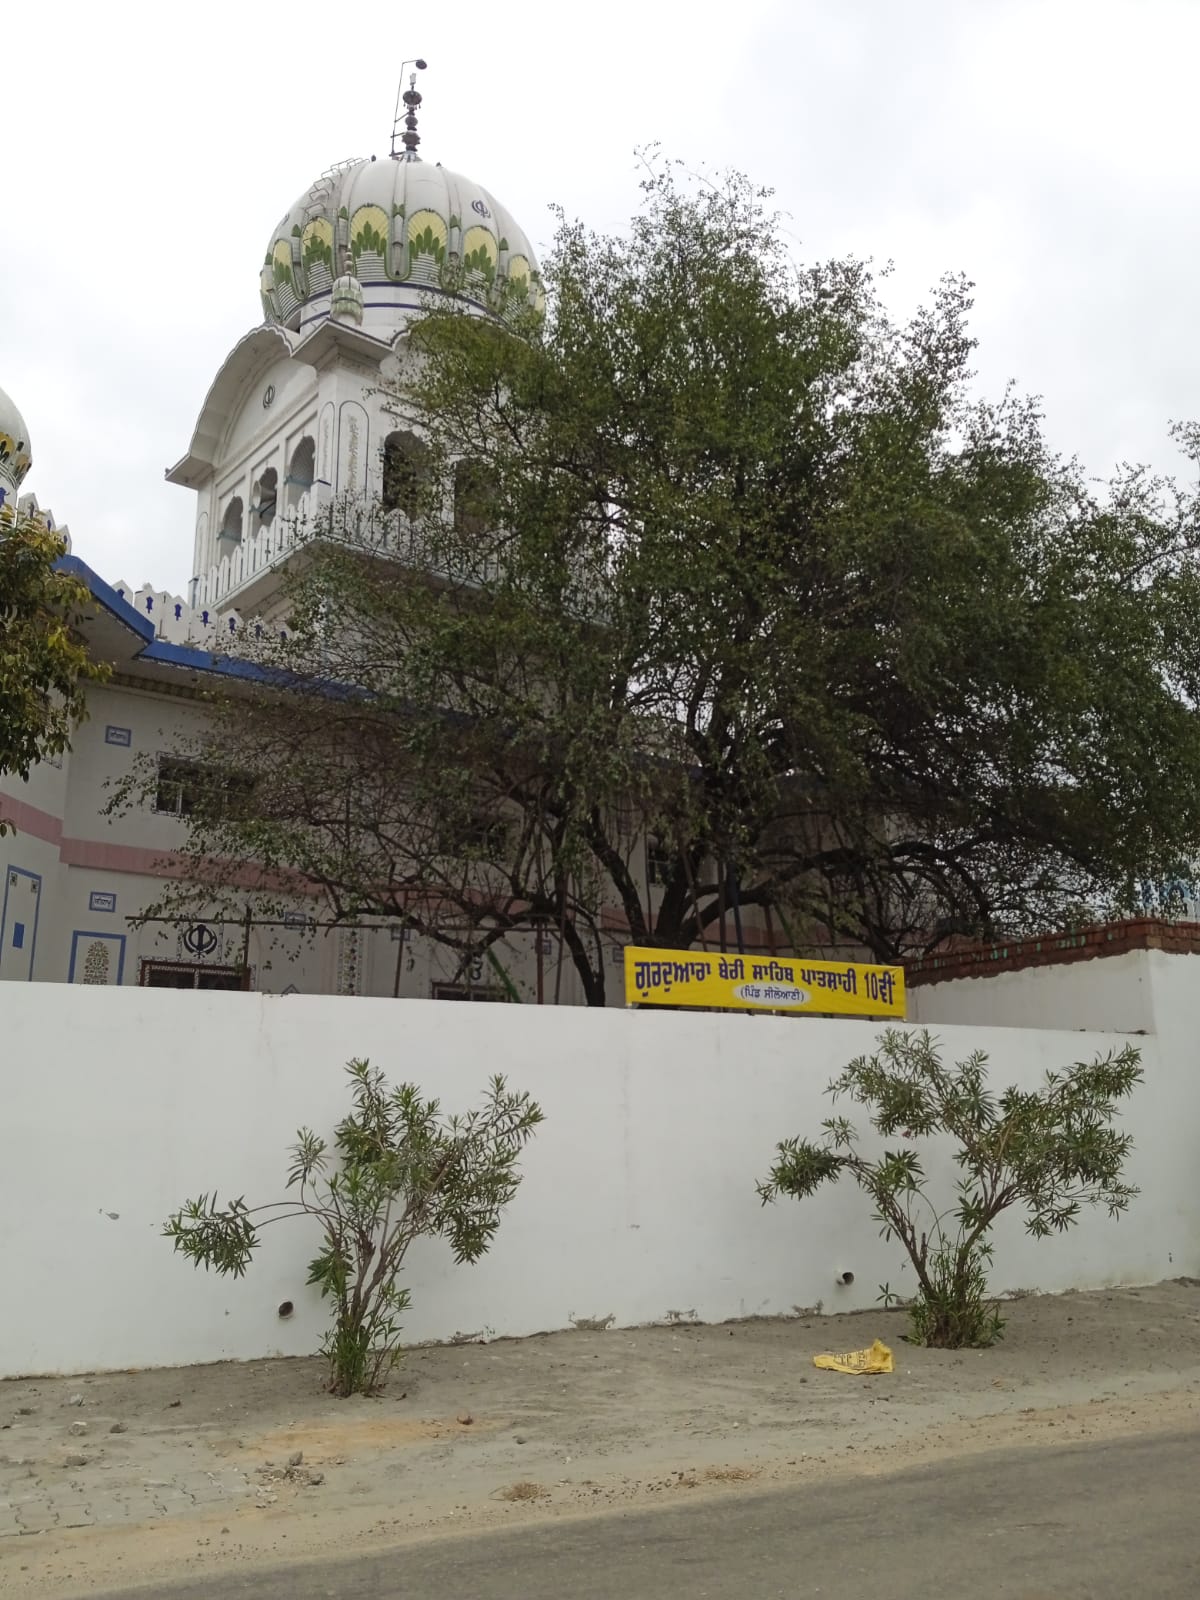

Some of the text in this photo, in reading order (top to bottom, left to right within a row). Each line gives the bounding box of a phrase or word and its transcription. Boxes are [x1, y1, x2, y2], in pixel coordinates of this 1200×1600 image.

[634, 962, 711, 997] ਗੁਰਦੁਆਰਾ
[718, 956, 745, 980] ਬੇਰੀ
[752, 961, 794, 983] ਸਾਹਿਬ
